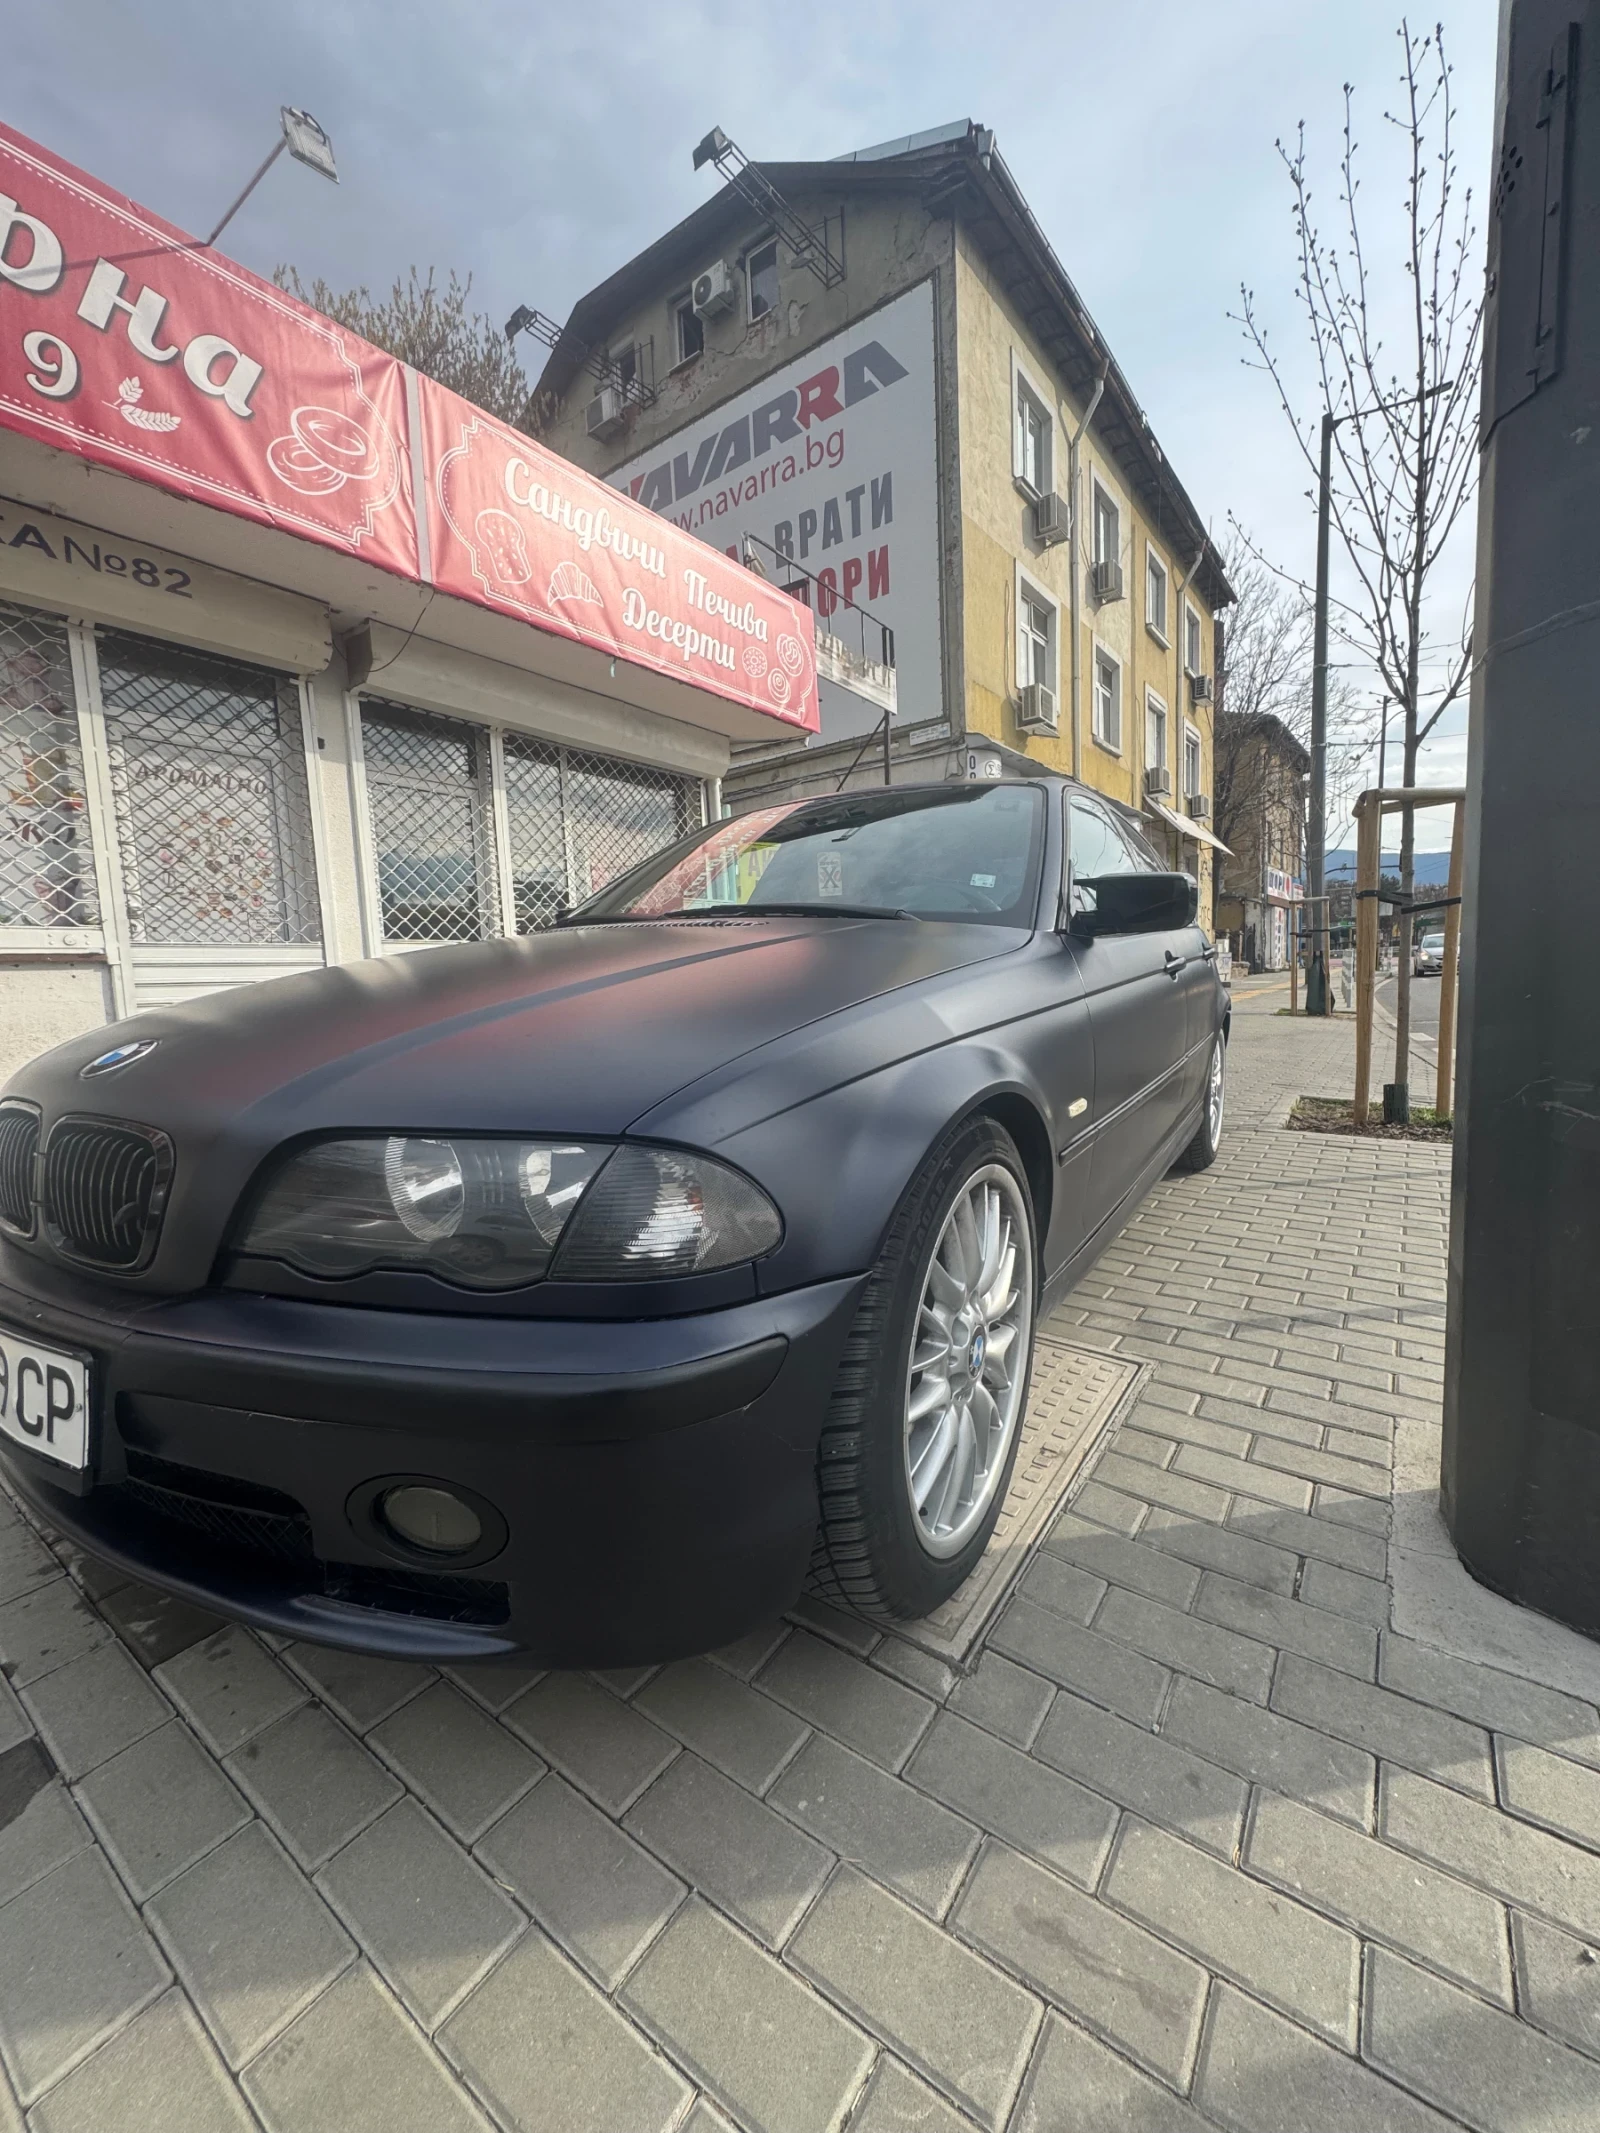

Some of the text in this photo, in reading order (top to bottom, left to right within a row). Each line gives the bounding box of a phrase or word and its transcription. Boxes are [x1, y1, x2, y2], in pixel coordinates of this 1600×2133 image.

[23, 331, 78, 396] 9
[504, 457, 667, 579] Сандвичи
[774, 470, 893, 570] ВРАТИ
[622, 587, 736, 671] Десерти
[684, 568, 768, 643] Печива
